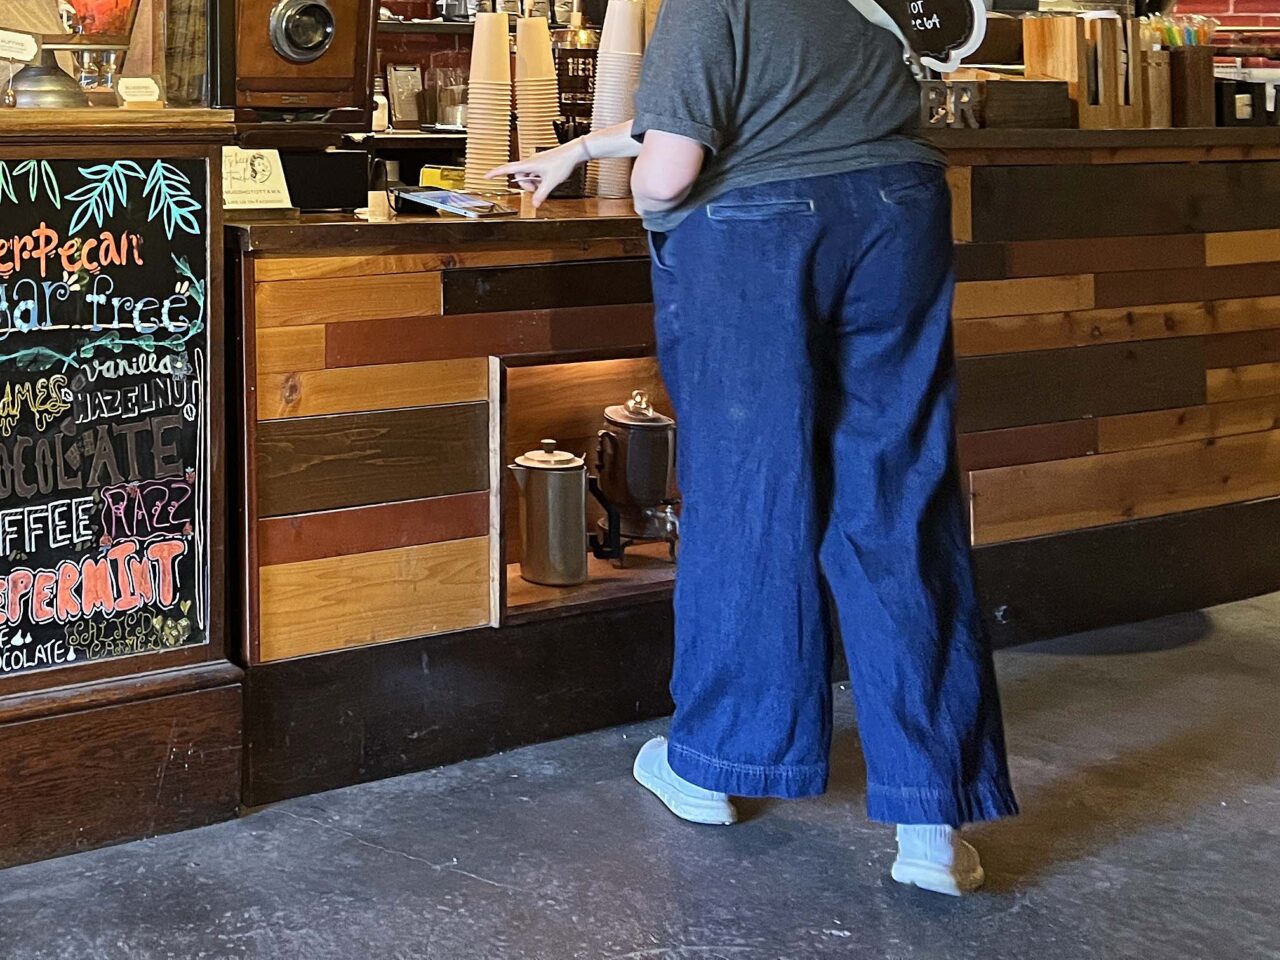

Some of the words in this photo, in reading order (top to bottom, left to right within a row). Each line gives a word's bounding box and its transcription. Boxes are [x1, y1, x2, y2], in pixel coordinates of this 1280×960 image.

[85, 274, 193, 332] free
[80, 352, 173, 383] vanilla
[74, 375, 202, 425] HAZELNUT
[102, 483, 192, 537] RAZZ
[69, 611, 154, 646] SALTED
